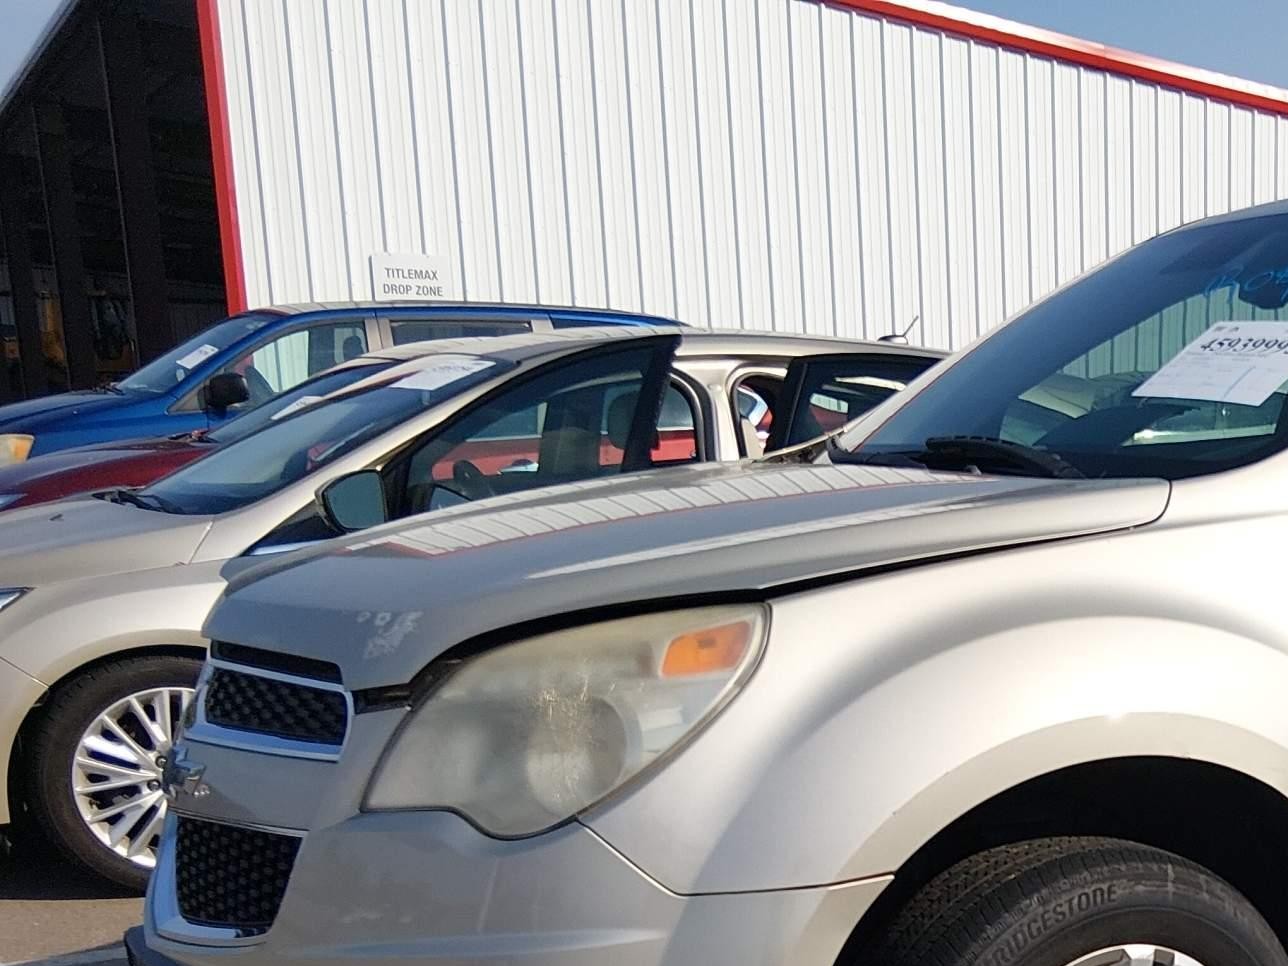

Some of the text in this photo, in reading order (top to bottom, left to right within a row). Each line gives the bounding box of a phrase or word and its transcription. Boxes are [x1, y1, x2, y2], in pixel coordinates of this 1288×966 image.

[384, 267, 439, 281] TITLEMAX
[383, 283, 443, 297] DROP ZONE
